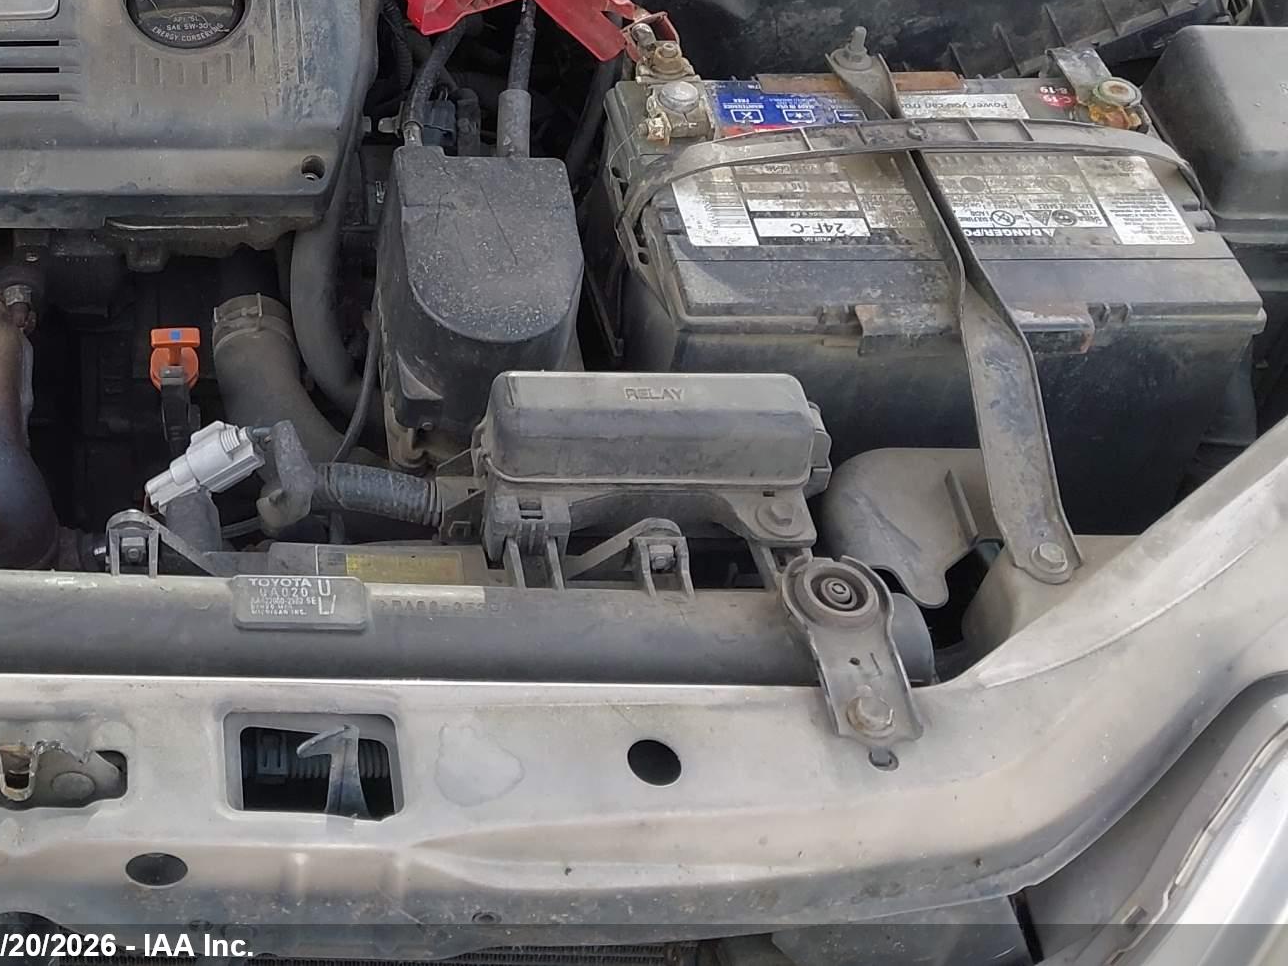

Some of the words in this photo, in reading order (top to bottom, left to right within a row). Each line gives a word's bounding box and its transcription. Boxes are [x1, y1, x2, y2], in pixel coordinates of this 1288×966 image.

[947, 100, 968, 109] you
[970, 101, 1008, 109] Power
[790, 222, 846, 234] 24F-C
[624, 386, 685, 402] RELAY
[248, 577, 312, 587] TOYOTA
